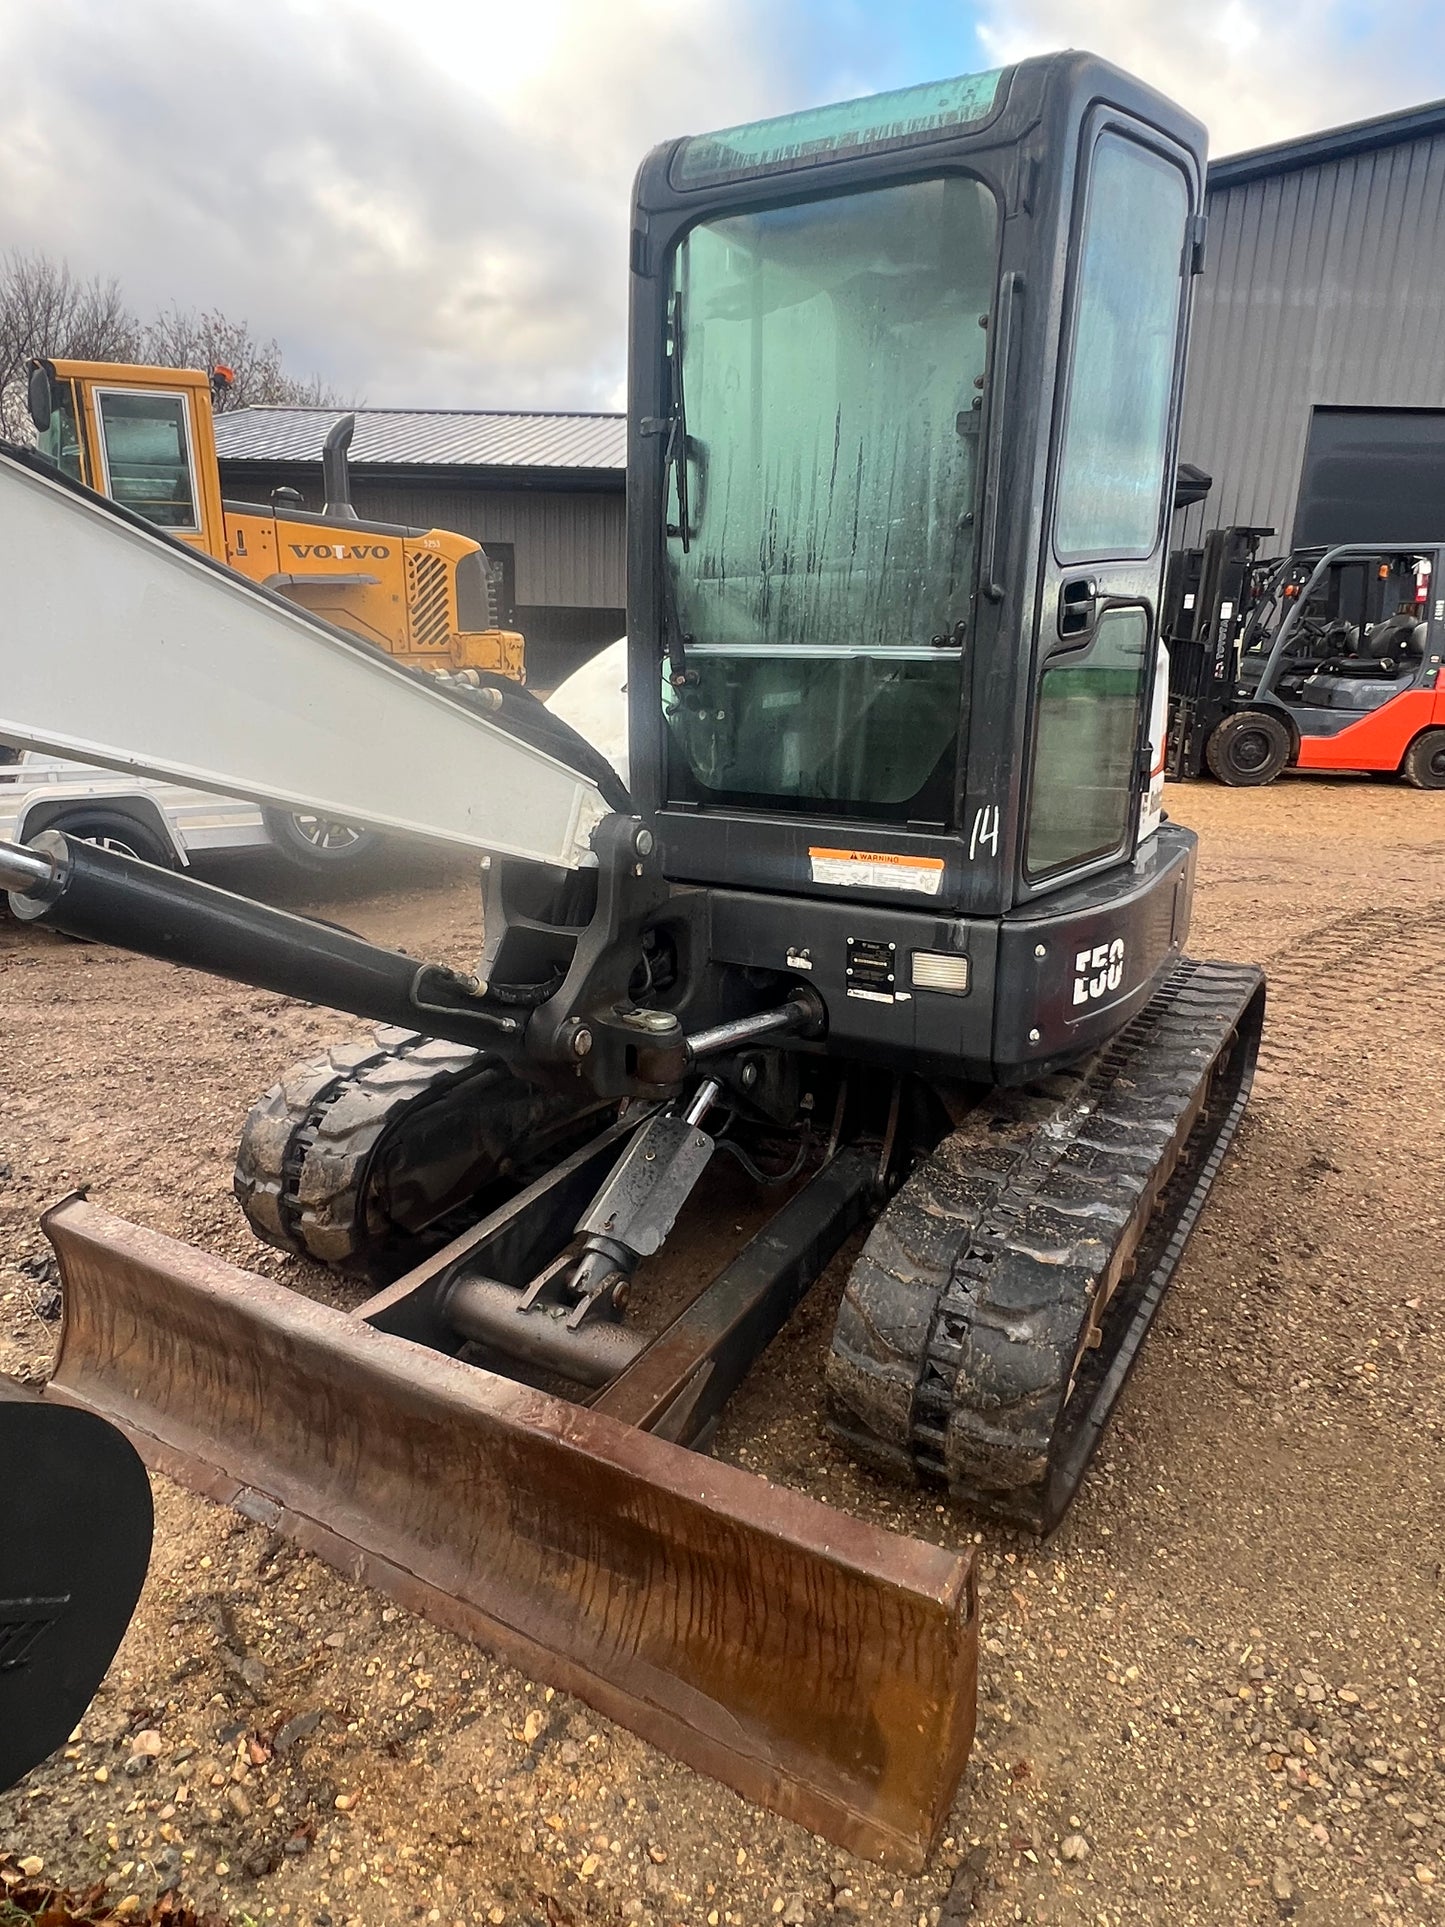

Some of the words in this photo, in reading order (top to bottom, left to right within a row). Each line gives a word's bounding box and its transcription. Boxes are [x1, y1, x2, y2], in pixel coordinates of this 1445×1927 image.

[288, 544, 390, 560] VOLVO
[969, 804, 1000, 860] 14
[859, 853, 900, 864] WARNING
[1072, 938, 1125, 1006] E50
